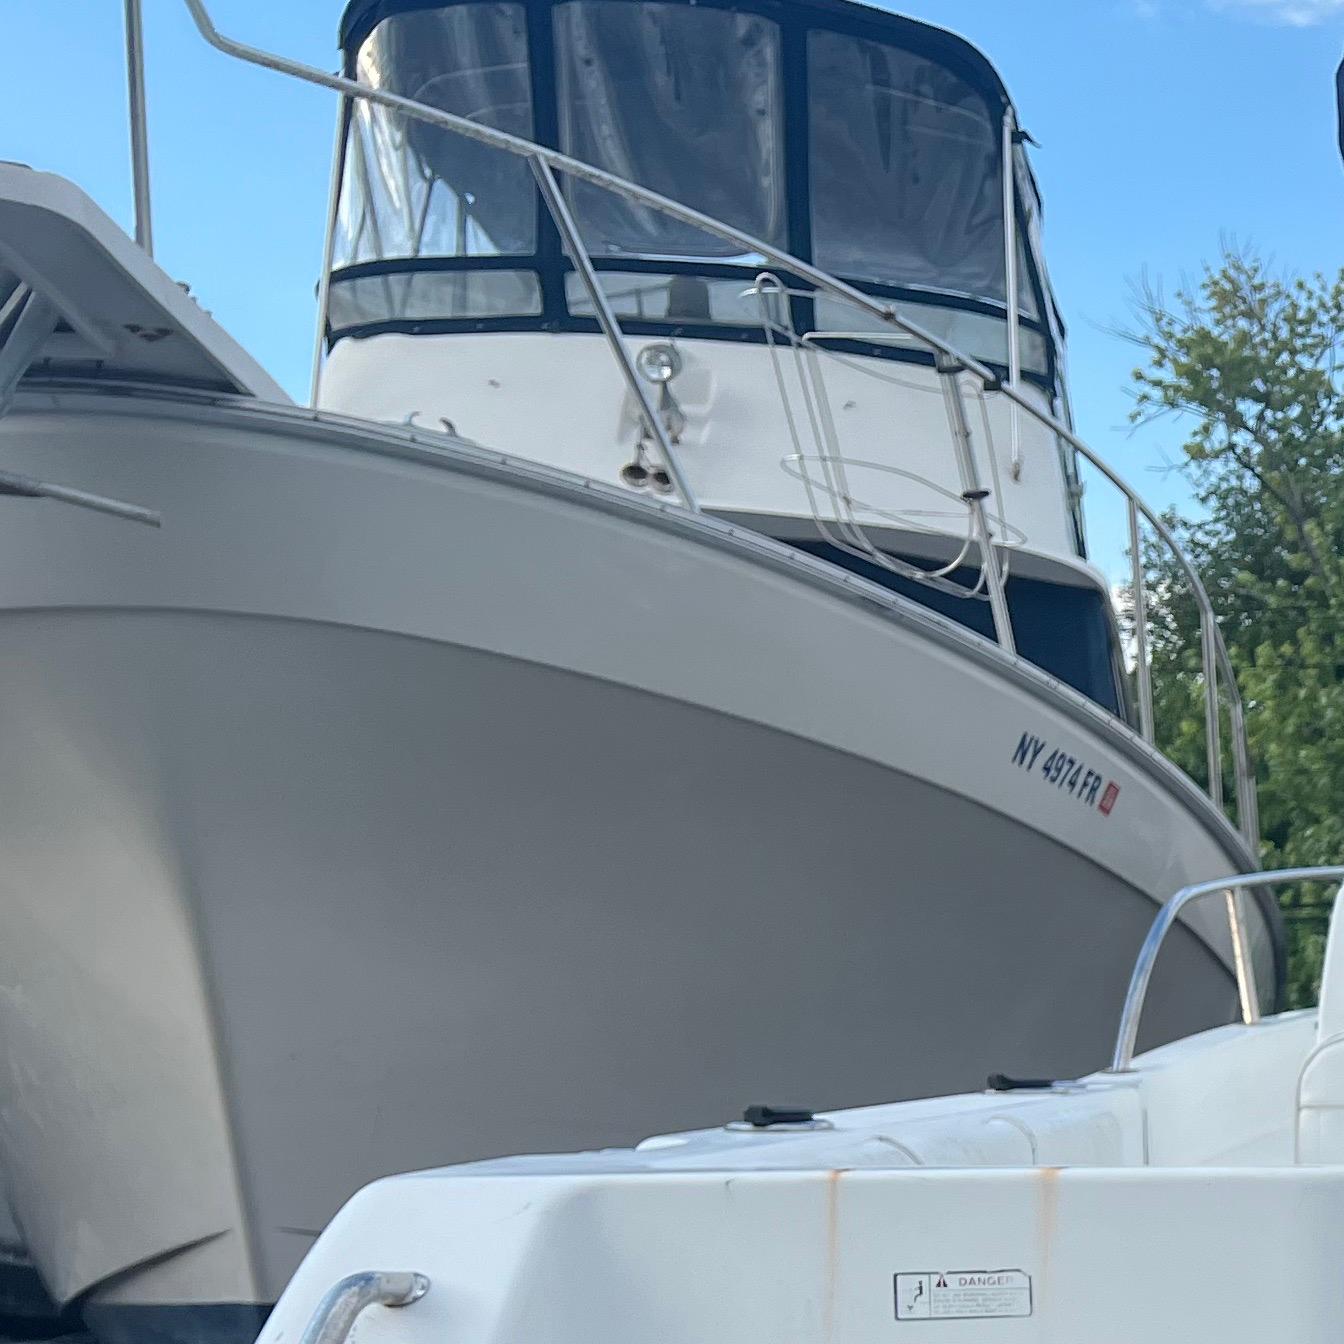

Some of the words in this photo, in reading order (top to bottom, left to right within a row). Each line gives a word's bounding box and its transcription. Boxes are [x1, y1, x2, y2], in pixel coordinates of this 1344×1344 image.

[1011, 731, 1047, 773] NY
[1042, 747, 1086, 794] 4974
[1076, 768, 1103, 807] FR
